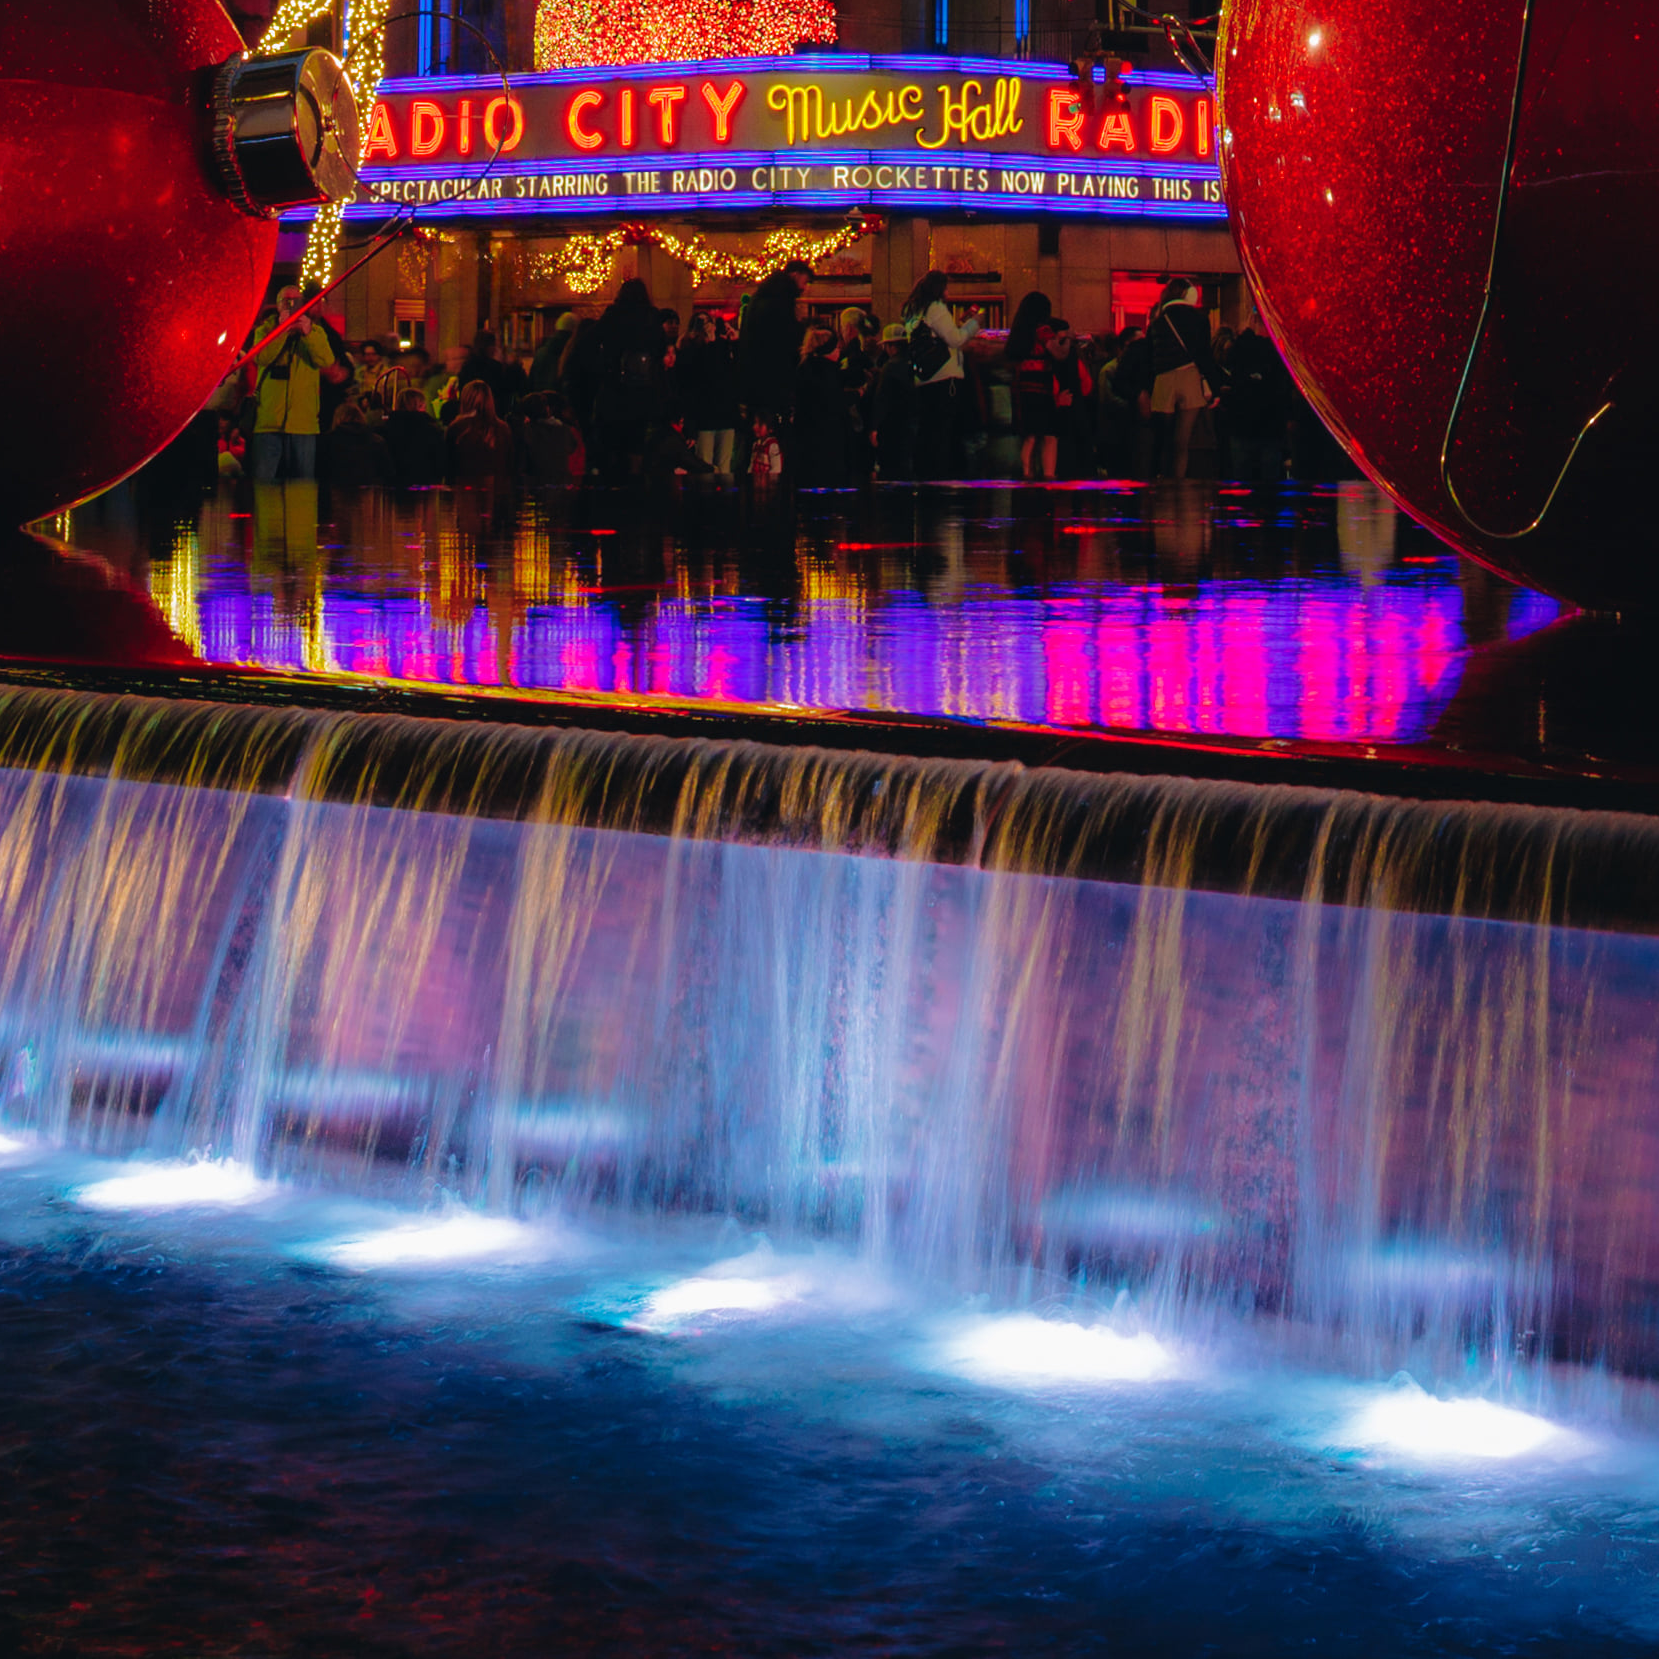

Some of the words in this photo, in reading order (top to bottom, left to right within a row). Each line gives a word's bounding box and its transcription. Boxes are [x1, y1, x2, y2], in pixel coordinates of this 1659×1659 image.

[568, 81, 743, 149] CITY
[767, 83, 925, 145] Music
[916, 76, 1024, 149] Hall
[370, 178, 503, 203] SPECTACULAR
[515, 173, 608, 199] STARRING
[622, 171, 661, 195] THE
[672, 168, 737, 193] RADIO
[752, 166, 811, 191] CITY
[833, 165, 989, 192] ROCKETTES
[1001, 170, 1046, 194] NOW
[1057, 172, 1139, 199] PLAYING
[1152, 177, 1192, 201] THIS
[1204, 180, 1221, 203] IS
